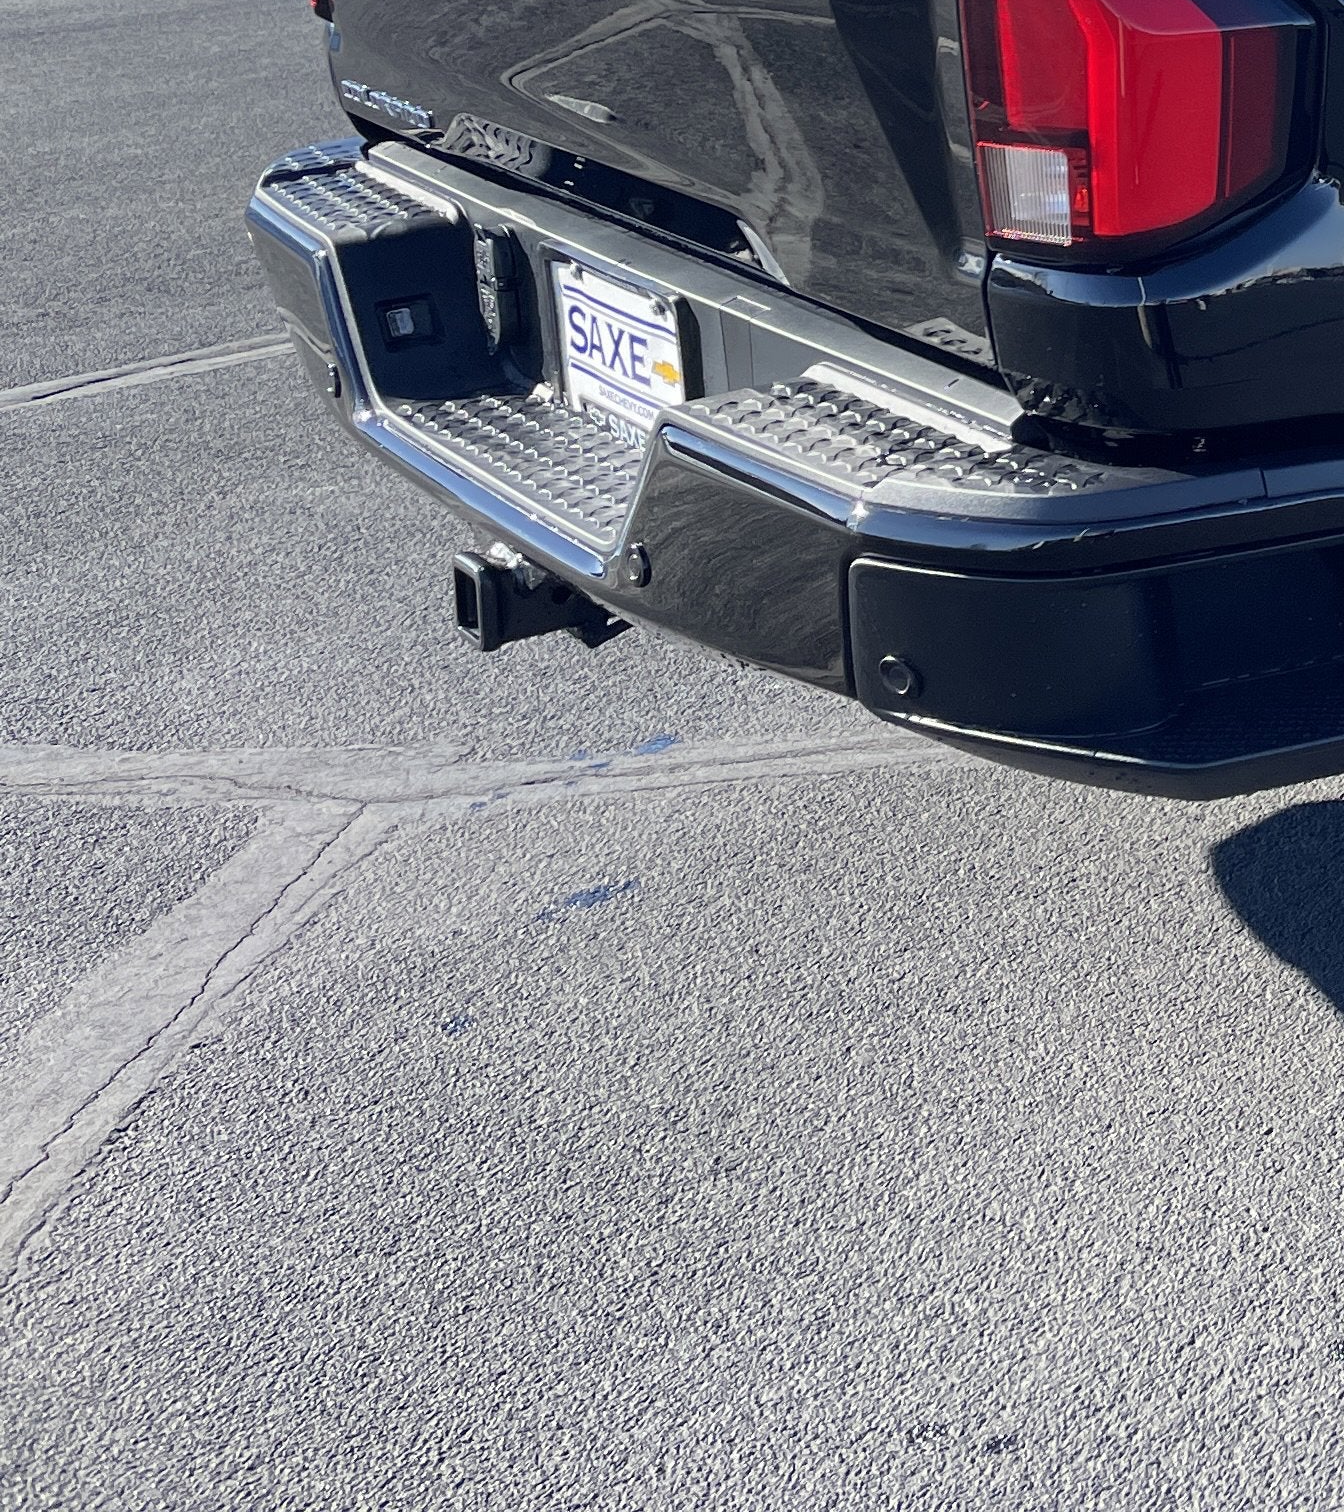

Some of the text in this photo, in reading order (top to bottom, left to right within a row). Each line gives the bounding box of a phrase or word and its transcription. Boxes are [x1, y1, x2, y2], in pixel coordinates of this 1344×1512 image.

[568, 305, 651, 386] SAXE
[600, 386, 654, 418] SAXECHEVY.COM
[608, 414, 646, 451] SAXE
